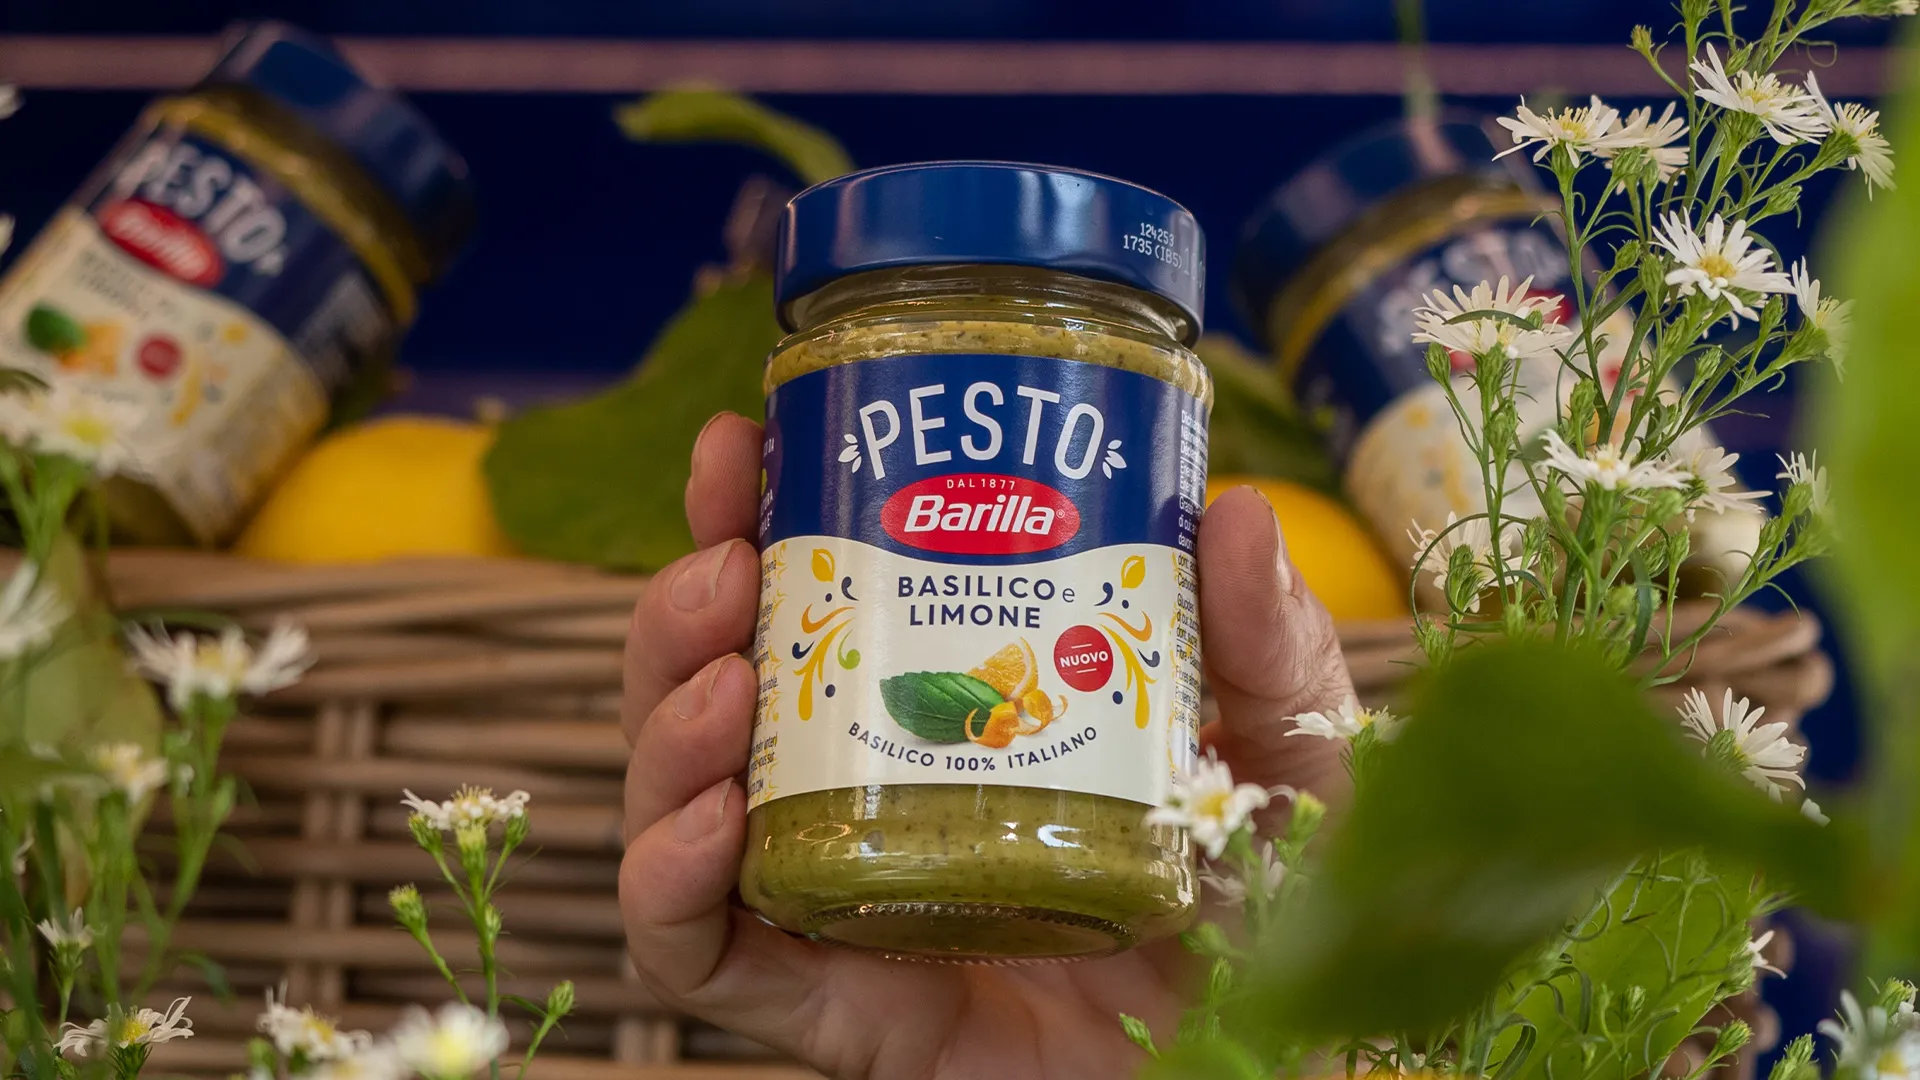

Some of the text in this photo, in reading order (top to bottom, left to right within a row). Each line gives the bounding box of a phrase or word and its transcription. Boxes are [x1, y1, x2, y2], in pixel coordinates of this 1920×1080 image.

[1140, 222, 1175, 248] 124253
[859, 381, 1105, 481] PESTO
[946, 478, 1016, 491] DAL 1877
[897, 574, 1076, 603] BASILICO e
[909, 604, 1041, 629] LIMONE
[1060, 650, 1109, 667] NUOVO
[848, 721, 1098, 772] BASILICO 100% ITALIANO
